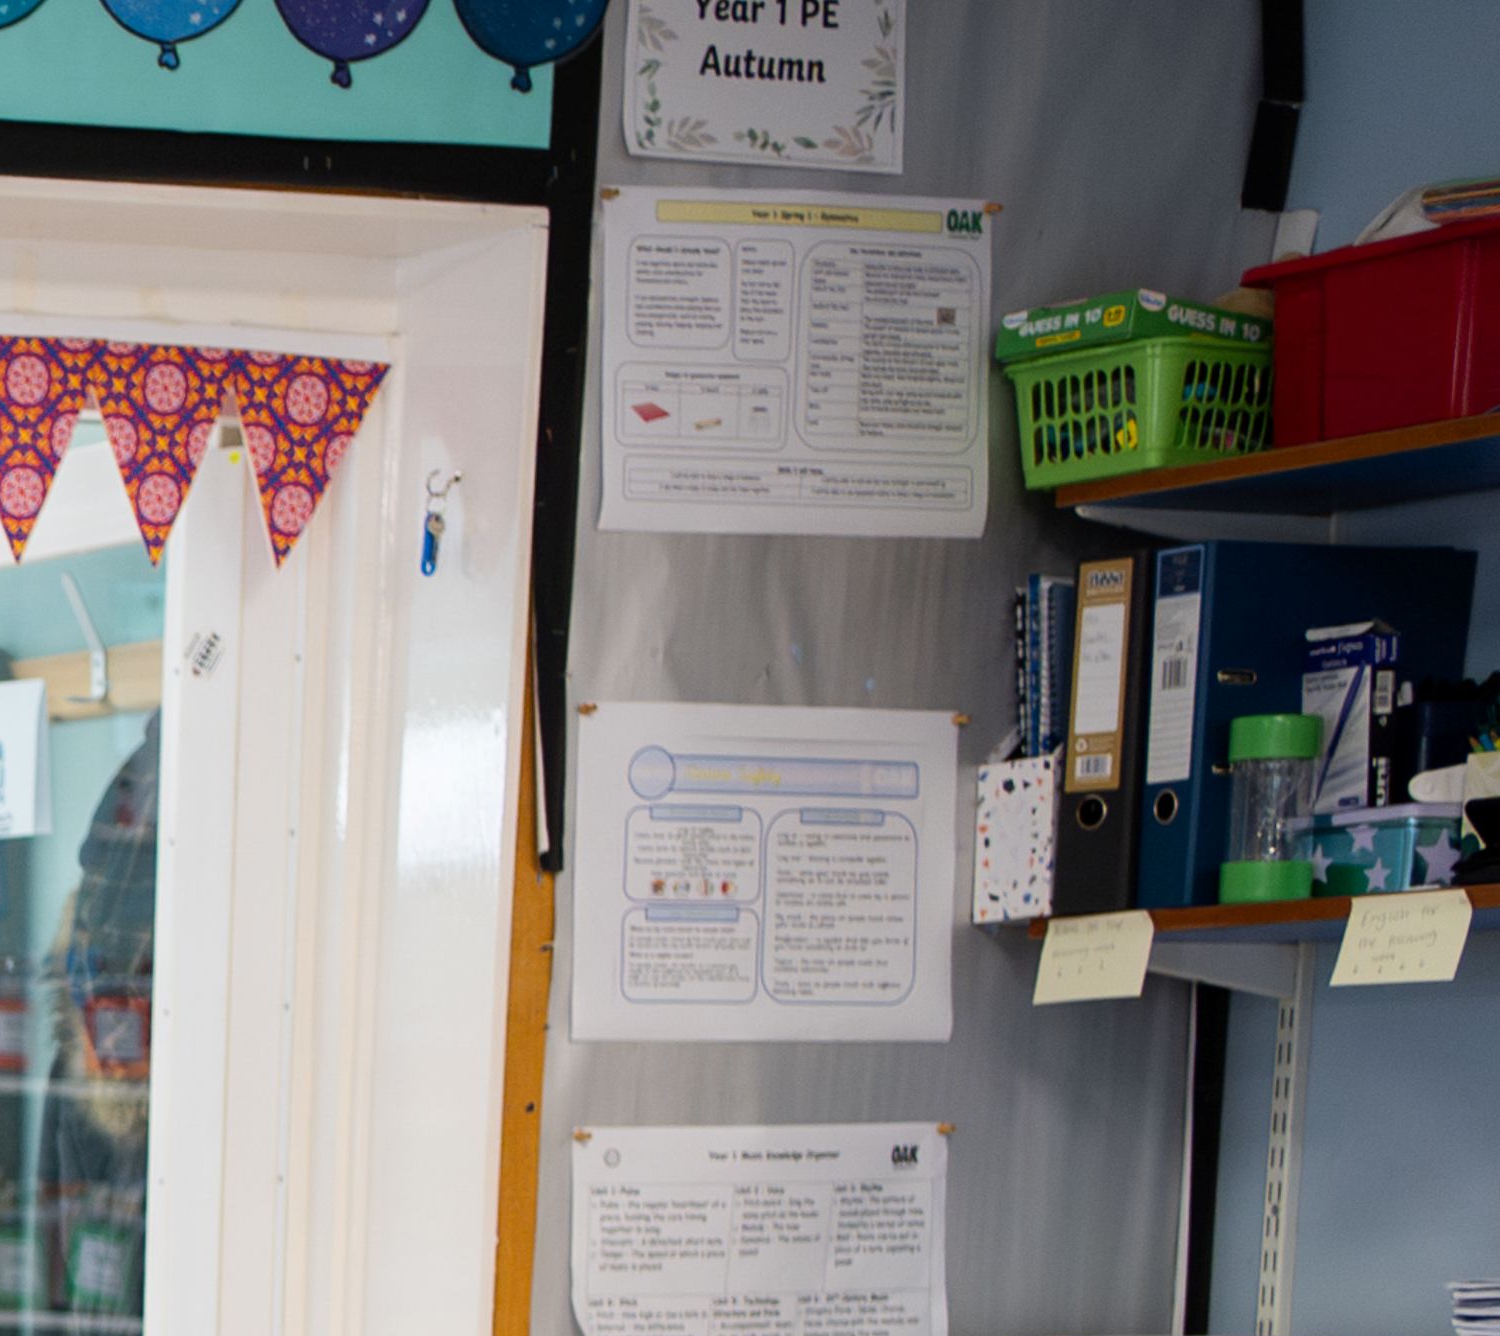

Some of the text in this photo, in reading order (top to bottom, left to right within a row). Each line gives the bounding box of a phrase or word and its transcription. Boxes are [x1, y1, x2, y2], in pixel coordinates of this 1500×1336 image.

[801, 0, 839, 28] PE
[700, 44, 826, 84] Autumn
[946, 208, 984, 234] OAK
[1063, 312, 1080, 328] IN
[1083, 307, 1103, 325] 10
[1167, 303, 1261, 341] GUESS IN 10
